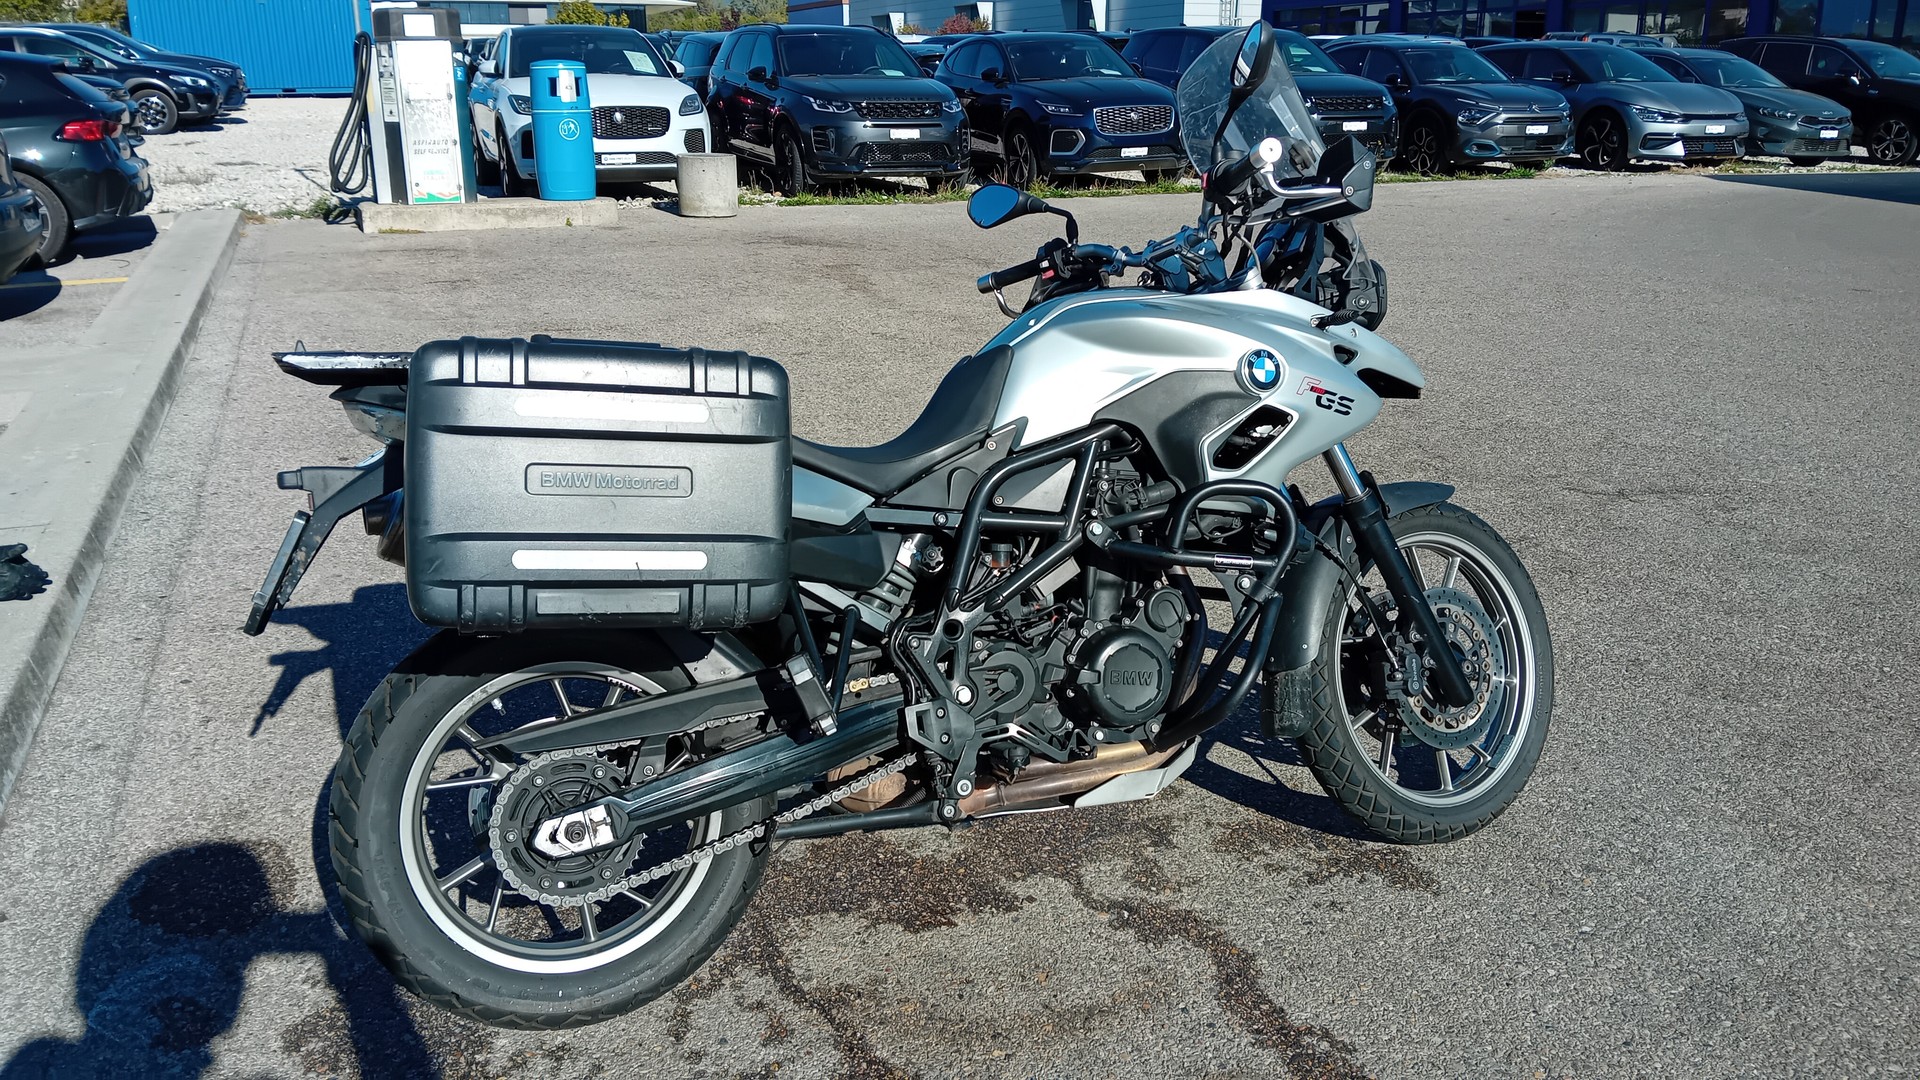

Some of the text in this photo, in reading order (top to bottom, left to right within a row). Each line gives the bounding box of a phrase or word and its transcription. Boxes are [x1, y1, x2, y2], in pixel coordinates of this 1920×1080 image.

[1249, 350, 1279, 365] BMW
[1315, 391, 1355, 416] GS
[540, 470, 679, 490] BMW Motorrad
[1110, 670, 1154, 686] BMW
